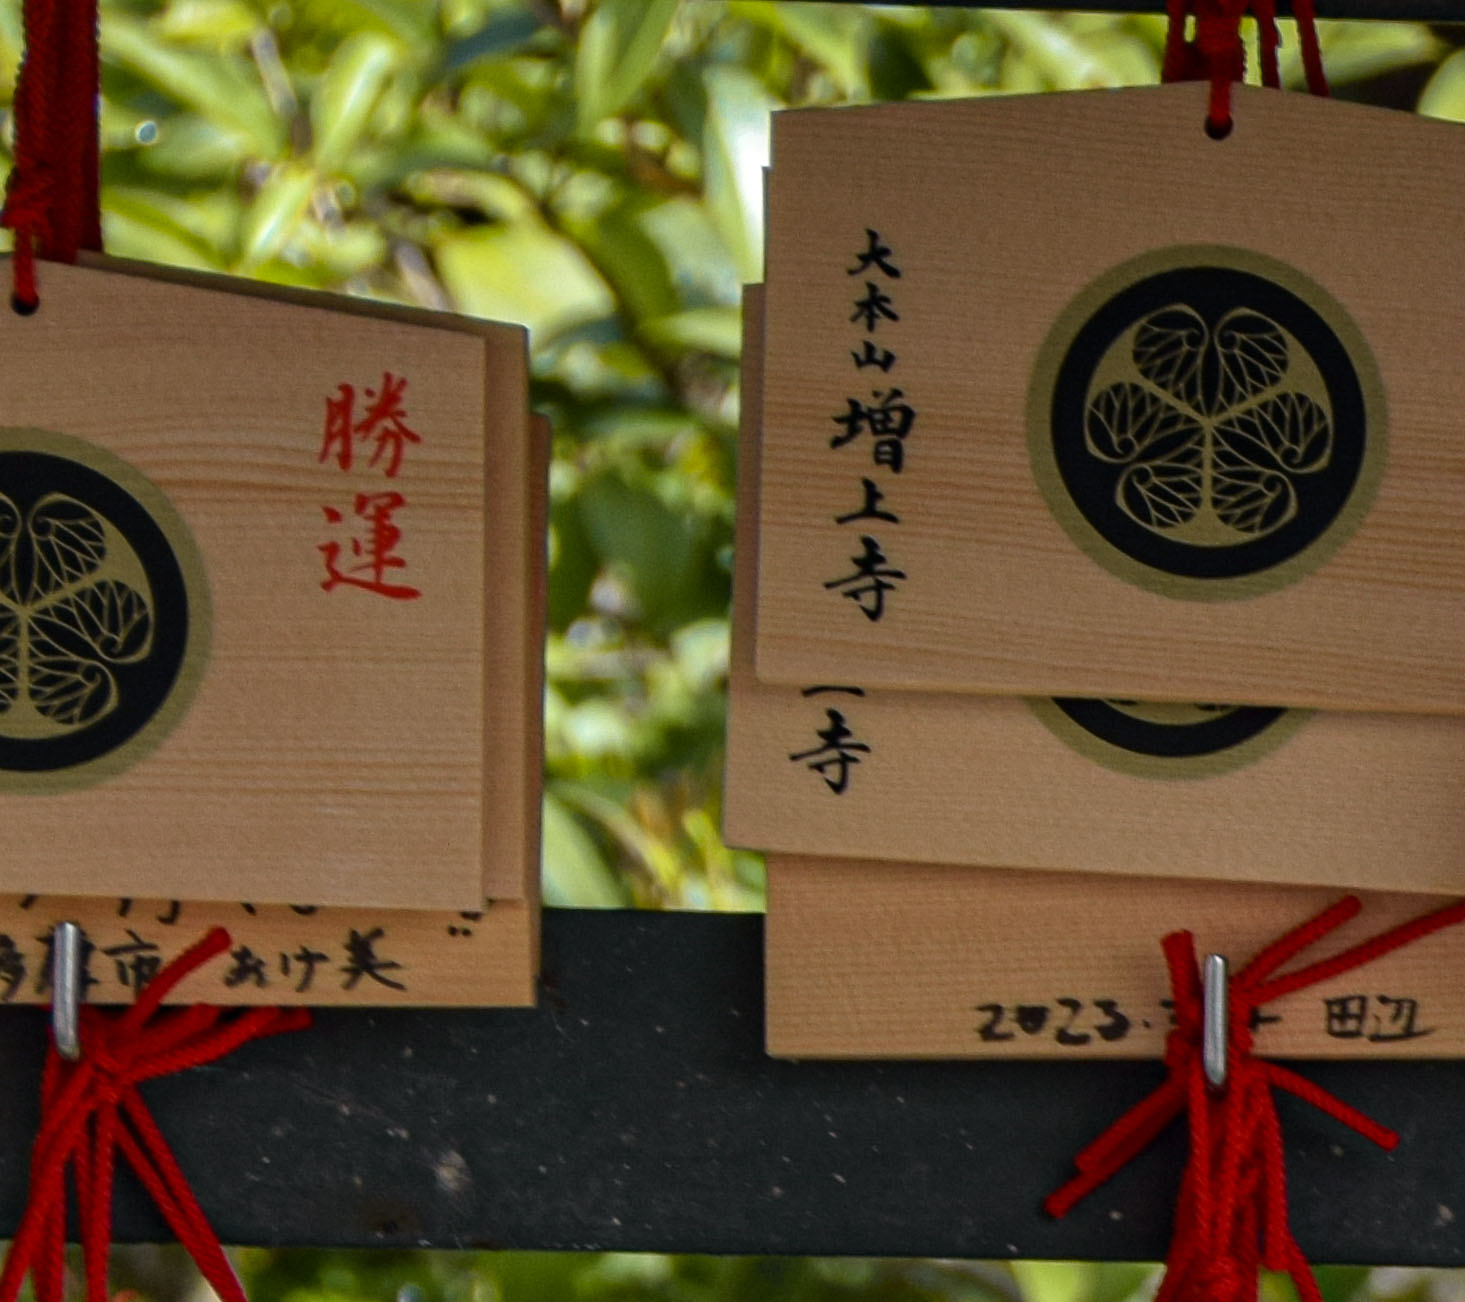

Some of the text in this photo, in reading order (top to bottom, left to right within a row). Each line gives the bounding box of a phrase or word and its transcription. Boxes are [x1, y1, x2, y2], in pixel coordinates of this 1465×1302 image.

[318, 373, 421, 601] 勝運
[823, 228, 915, 621] 大本山増上寺
